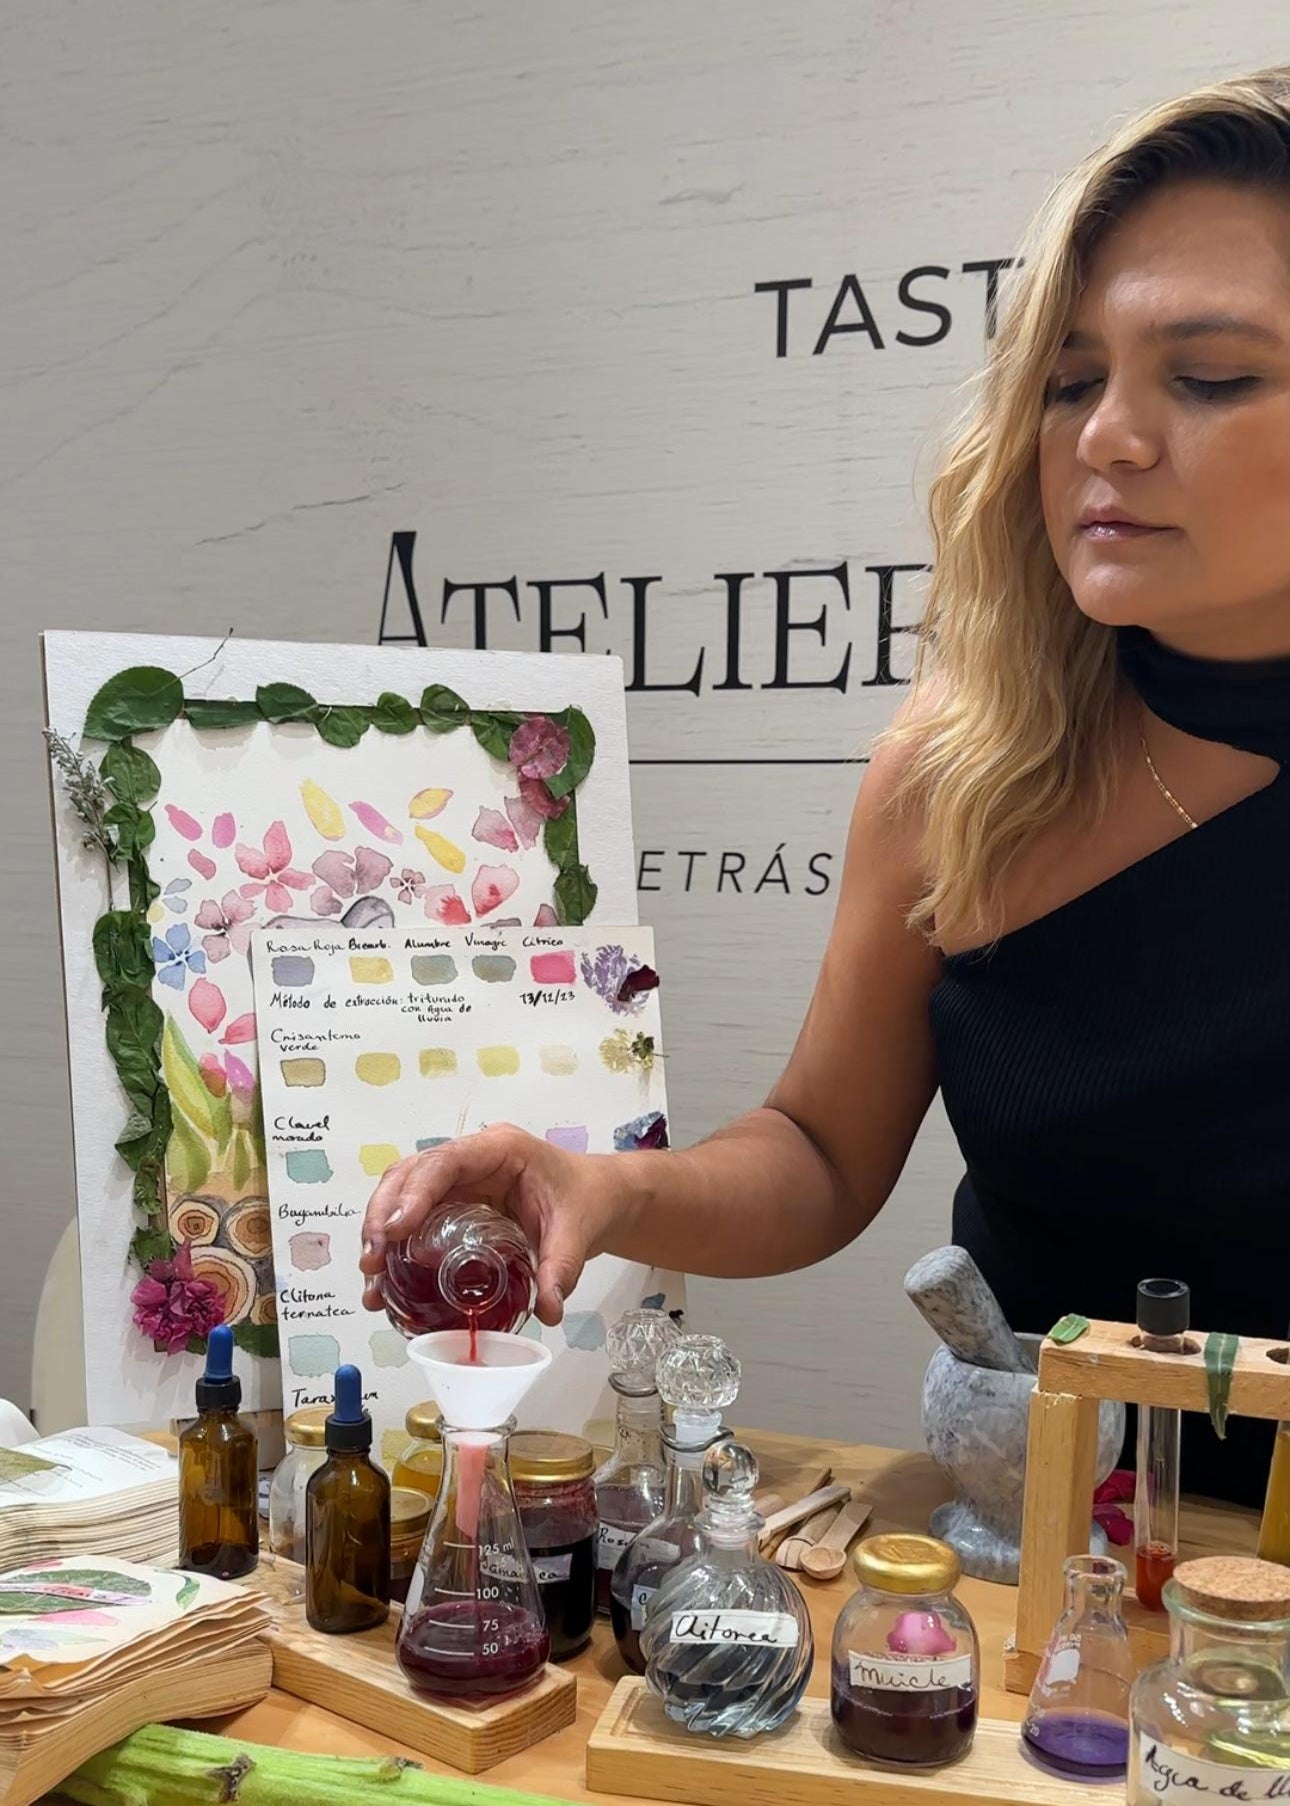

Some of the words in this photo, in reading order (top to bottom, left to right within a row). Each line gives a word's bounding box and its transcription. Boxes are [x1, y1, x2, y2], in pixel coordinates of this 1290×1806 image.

[754, 257, 1026, 358] TAST
[636, 843, 833, 896] ETRÁS
[266, 940, 312, 953] Rosa
[313, 938, 344, 956] Roja
[404, 938, 452, 949] Alumbre
[269, 992, 311, 1009] Método
[323, 994, 337, 1009] de
[400, 1004, 421, 1014] con
[458, 1003, 473, 1014] de
[279, 1042, 320, 1052] verde
[274, 1115, 330, 1131] Clavel
[271, 1131, 323, 1142] morado
[281, 1305, 356, 1321] ternatea
[478, 1543, 500, 1558] 125
[476, 1586, 500, 1600] 100
[483, 1619, 499, 1632] 75
[482, 1643, 499, 1655] 50
[1218, 1780, 1251, 1802] de
